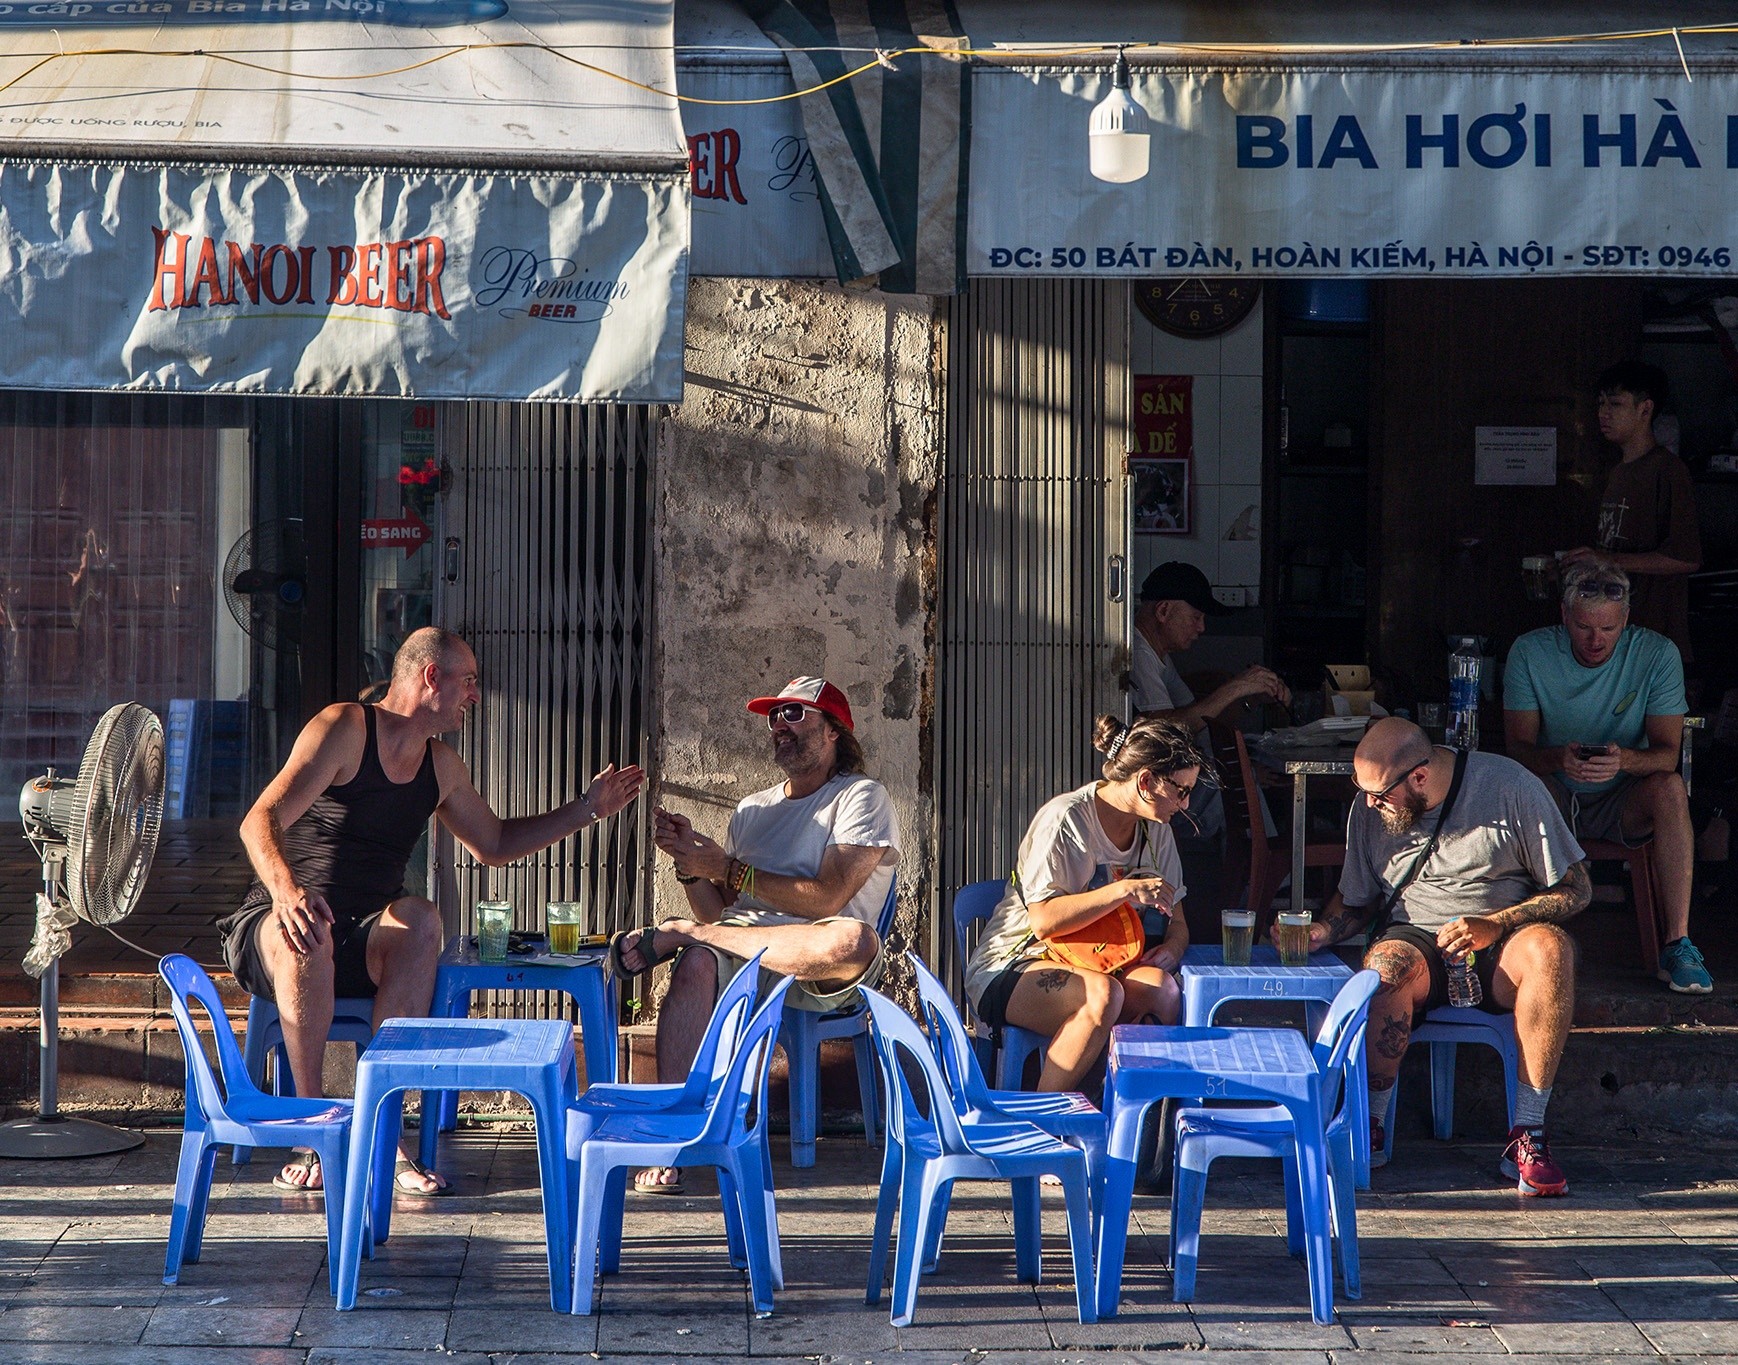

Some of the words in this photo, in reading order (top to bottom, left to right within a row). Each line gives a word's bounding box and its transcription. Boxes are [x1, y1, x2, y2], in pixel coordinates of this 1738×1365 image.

[187, 0, 246, 13] Bia
[1235, 114, 1379, 169] BIA
[1406, 103, 1552, 169] HƠI
[1583, 98, 1702, 168] HÀ
[988, 248, 1042, 268] ĐC:
[1051, 247, 1087, 268] 50
[1096, 241, 1157, 268] BÁT
[1165, 242, 1243, 271] ĐÀN,
[1252, 242, 1341, 268] HOÀN
[1351, 240, 1436, 272] KIẾM,
[1445, 241, 1490, 268] HÀ
[1498, 240, 1554, 273] NỘI
[1582, 245, 1650, 267] SĐT:
[1657, 246, 1732, 268] 0946
[148, 225, 316, 313] HANOI
[327, 235, 452, 320] BEER
[475, 246, 630, 306] Premium
[527, 303, 573, 319] BEER
[1141, 384, 1185, 415] SẢN
[381, 527, 422, 539] SANG
[1205, 1077, 1228, 1096] 51
